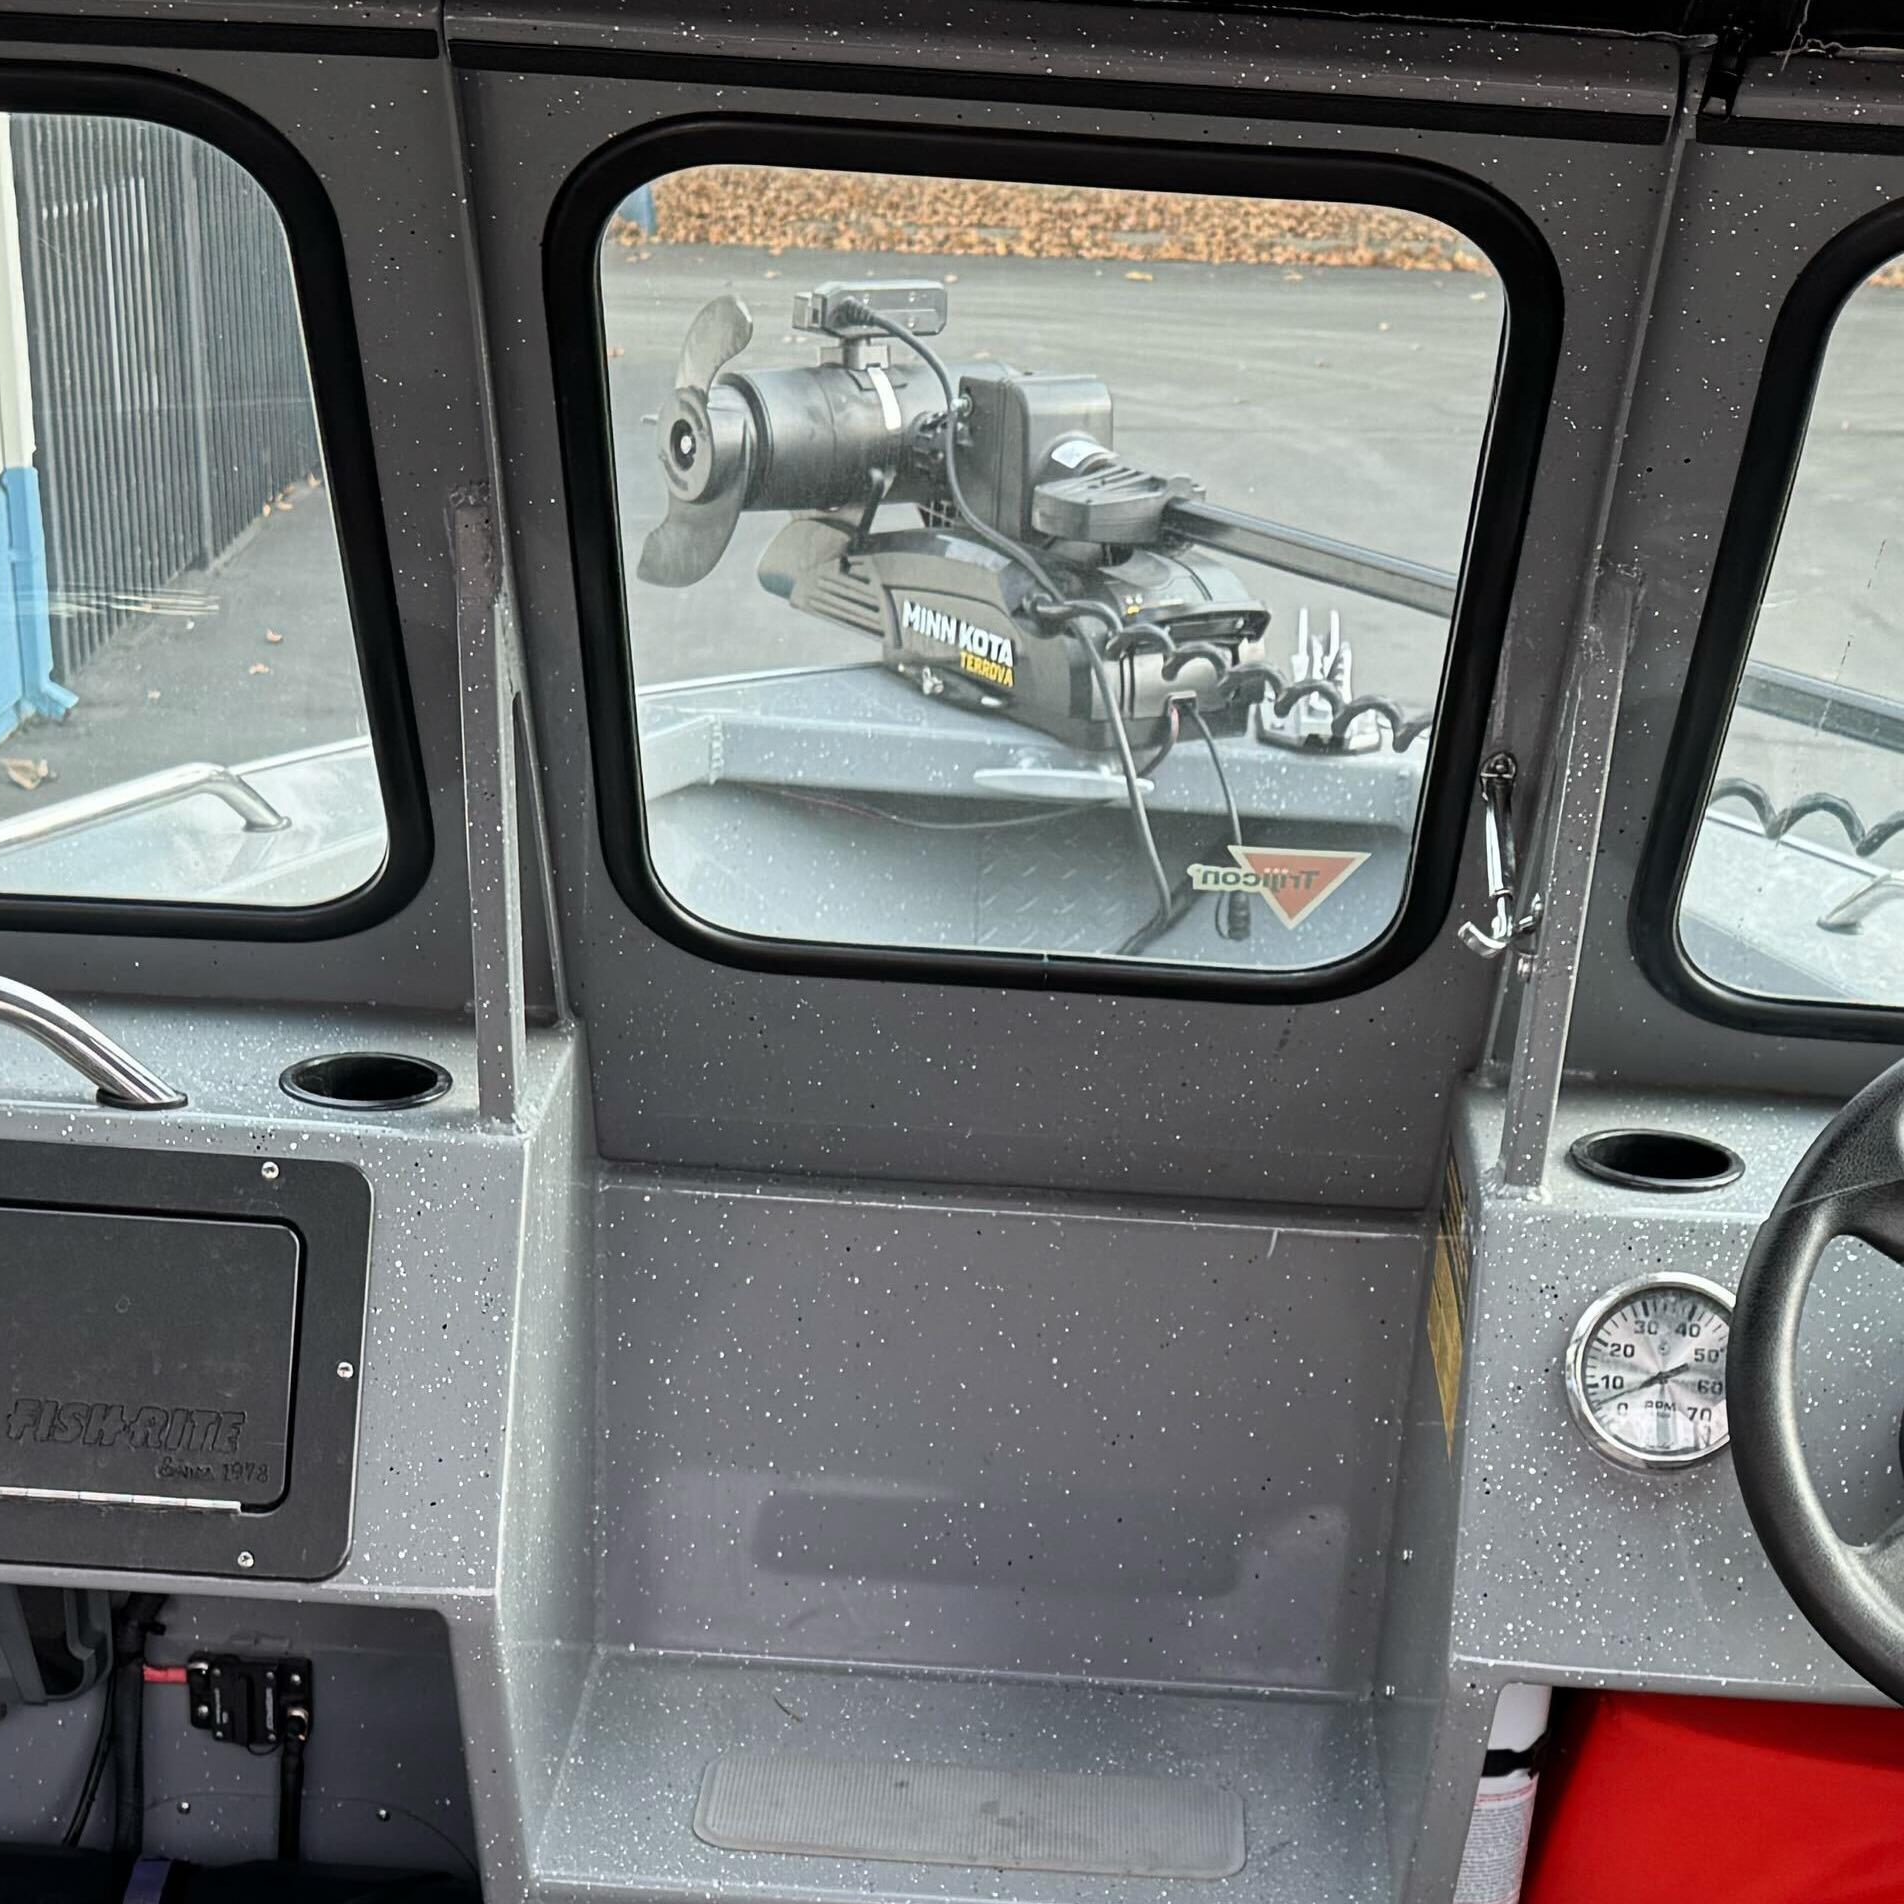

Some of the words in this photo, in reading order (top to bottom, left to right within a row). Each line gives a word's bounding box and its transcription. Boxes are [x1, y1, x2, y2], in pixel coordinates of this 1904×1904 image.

[902, 599, 957, 645] MINN
[958, 619, 1014, 668] KOTA
[959, 651, 1014, 688] TERROVA
[1634, 1320, 1659, 1336] 30
[1675, 1322, 1701, 1338] 40
[1609, 1342, 1635, 1358] 20
[1693, 1348, 1720, 1364] 50
[1601, 1375, 1624, 1390] 10
[1698, 1380, 1723, 1395] 60
[1687, 1406, 1712, 1422] 70
